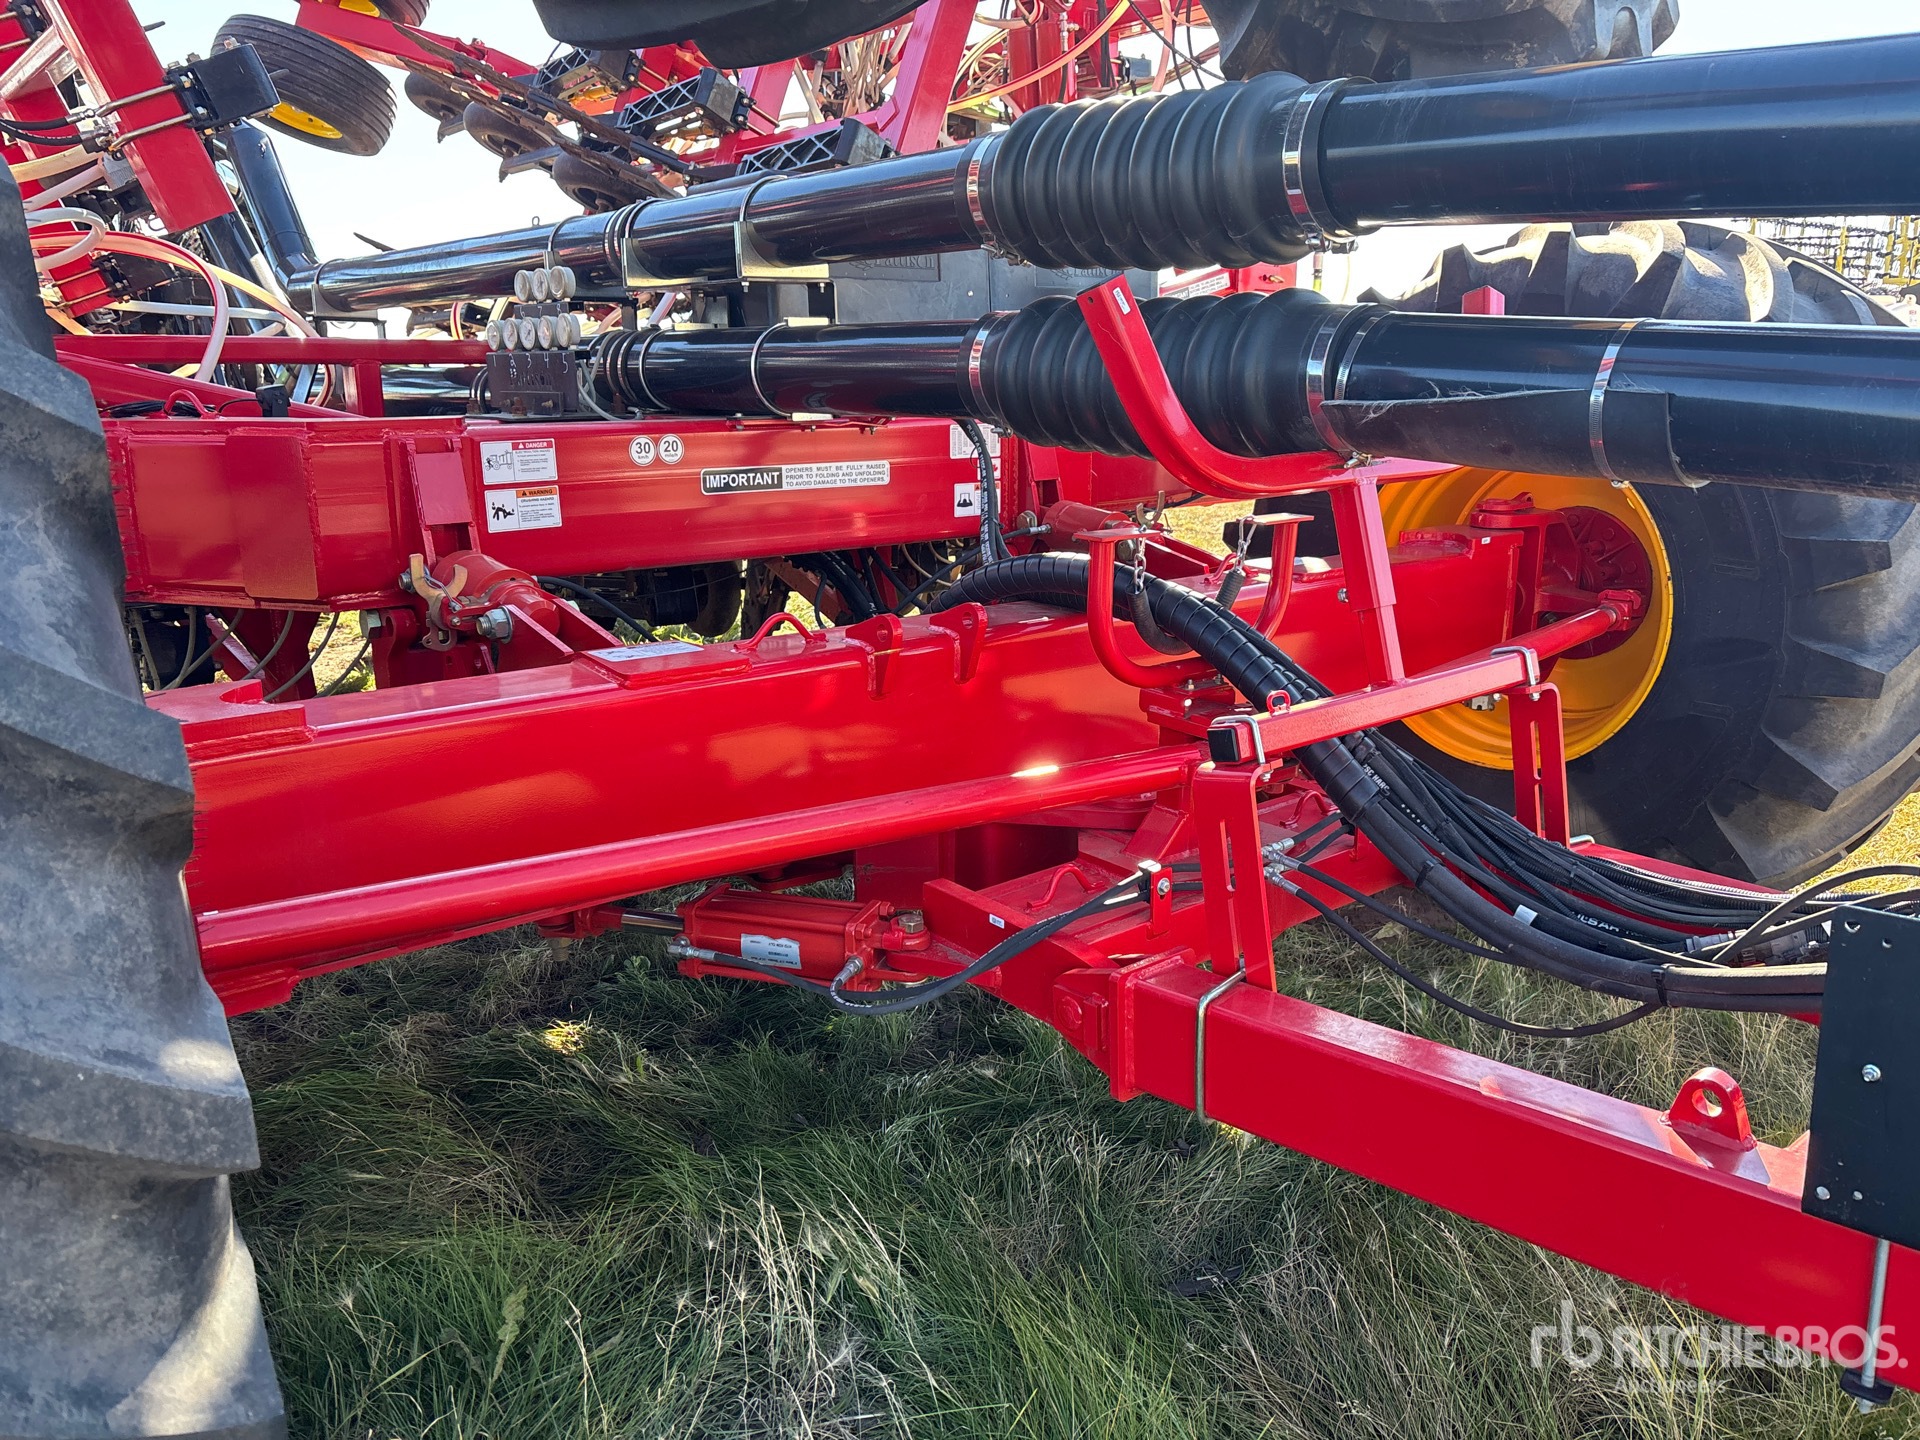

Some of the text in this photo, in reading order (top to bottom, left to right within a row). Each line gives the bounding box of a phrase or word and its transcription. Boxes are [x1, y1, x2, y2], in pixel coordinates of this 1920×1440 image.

[537, 306, 543, 316] 7
[526, 353, 532, 368] 3
[543, 353, 550, 368] 4
[562, 353, 570, 374] 5
[525, 441, 548, 449] DANGER
[635, 440, 679, 454] 30 20
[705, 472, 780, 488] IMPORTANT
[528, 488, 553, 496] WARNING
